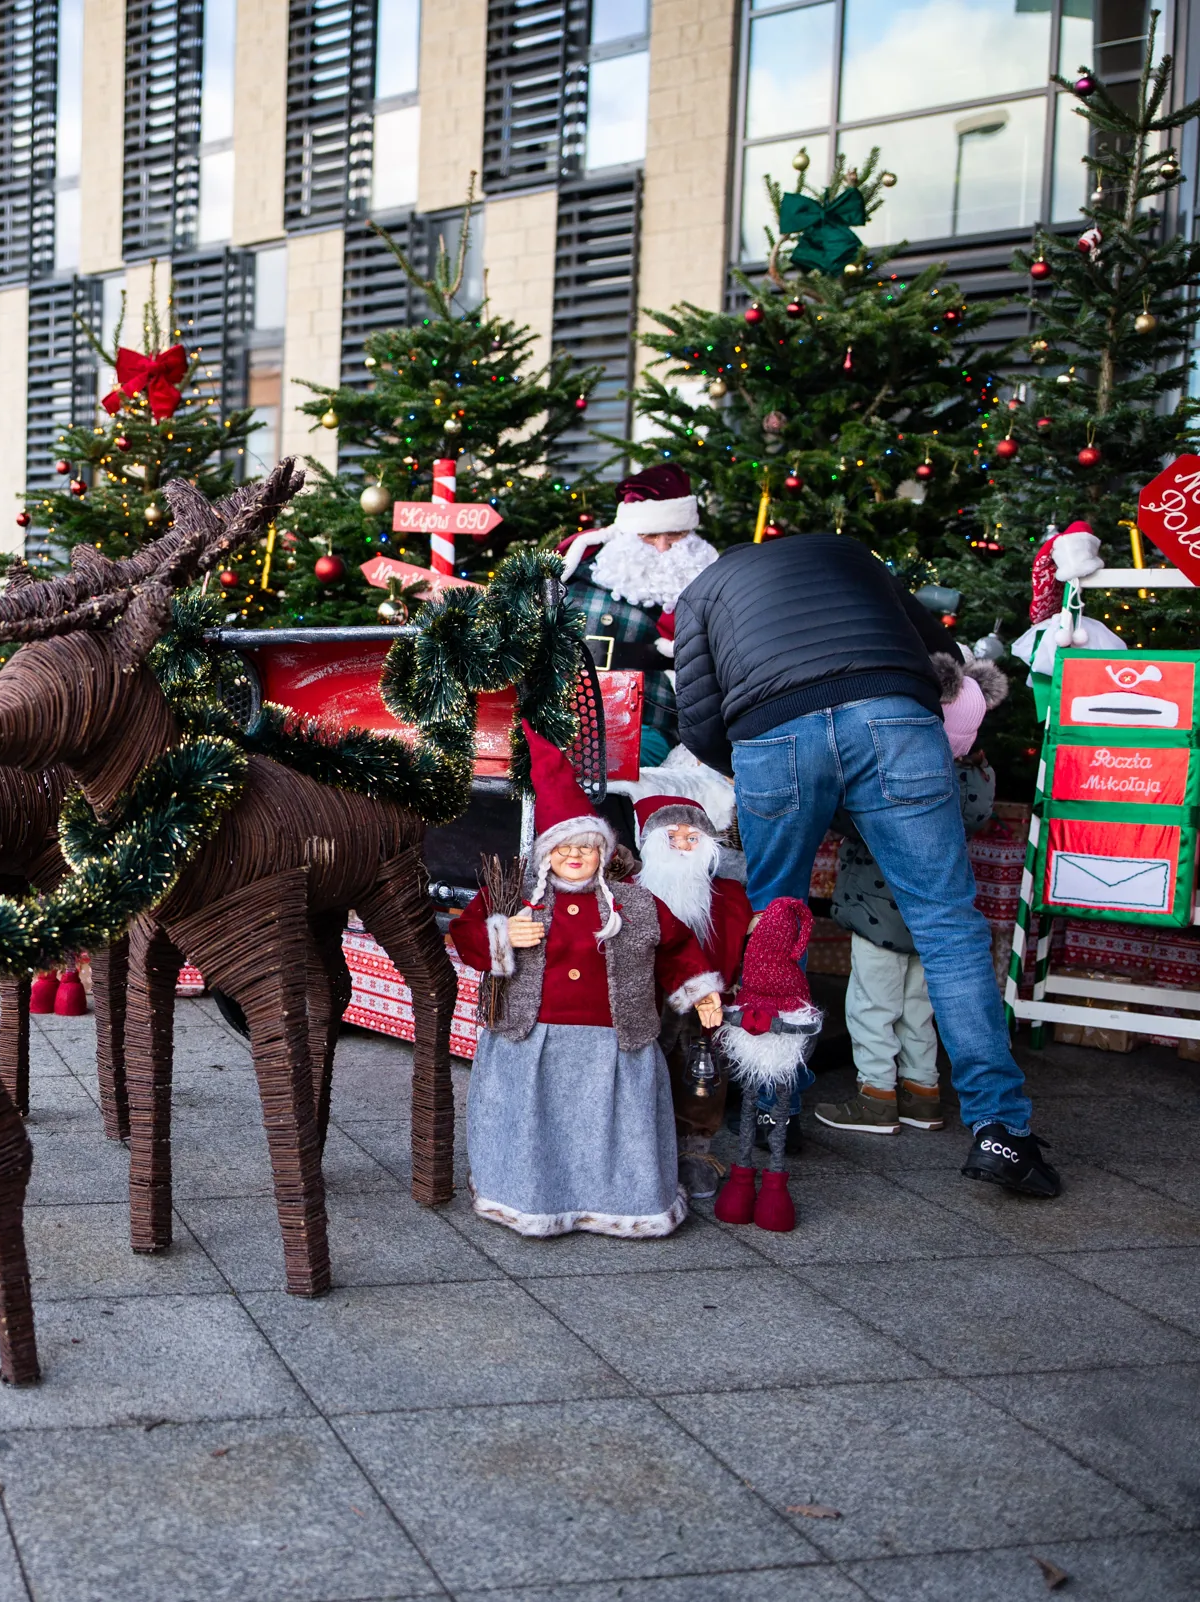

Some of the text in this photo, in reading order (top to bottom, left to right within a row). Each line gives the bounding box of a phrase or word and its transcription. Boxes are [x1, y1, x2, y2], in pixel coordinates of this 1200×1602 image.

[456, 508, 490, 530] 690
[1089, 748, 1153, 769] Poczta
[1080, 775, 1161, 796] Mikołaja
